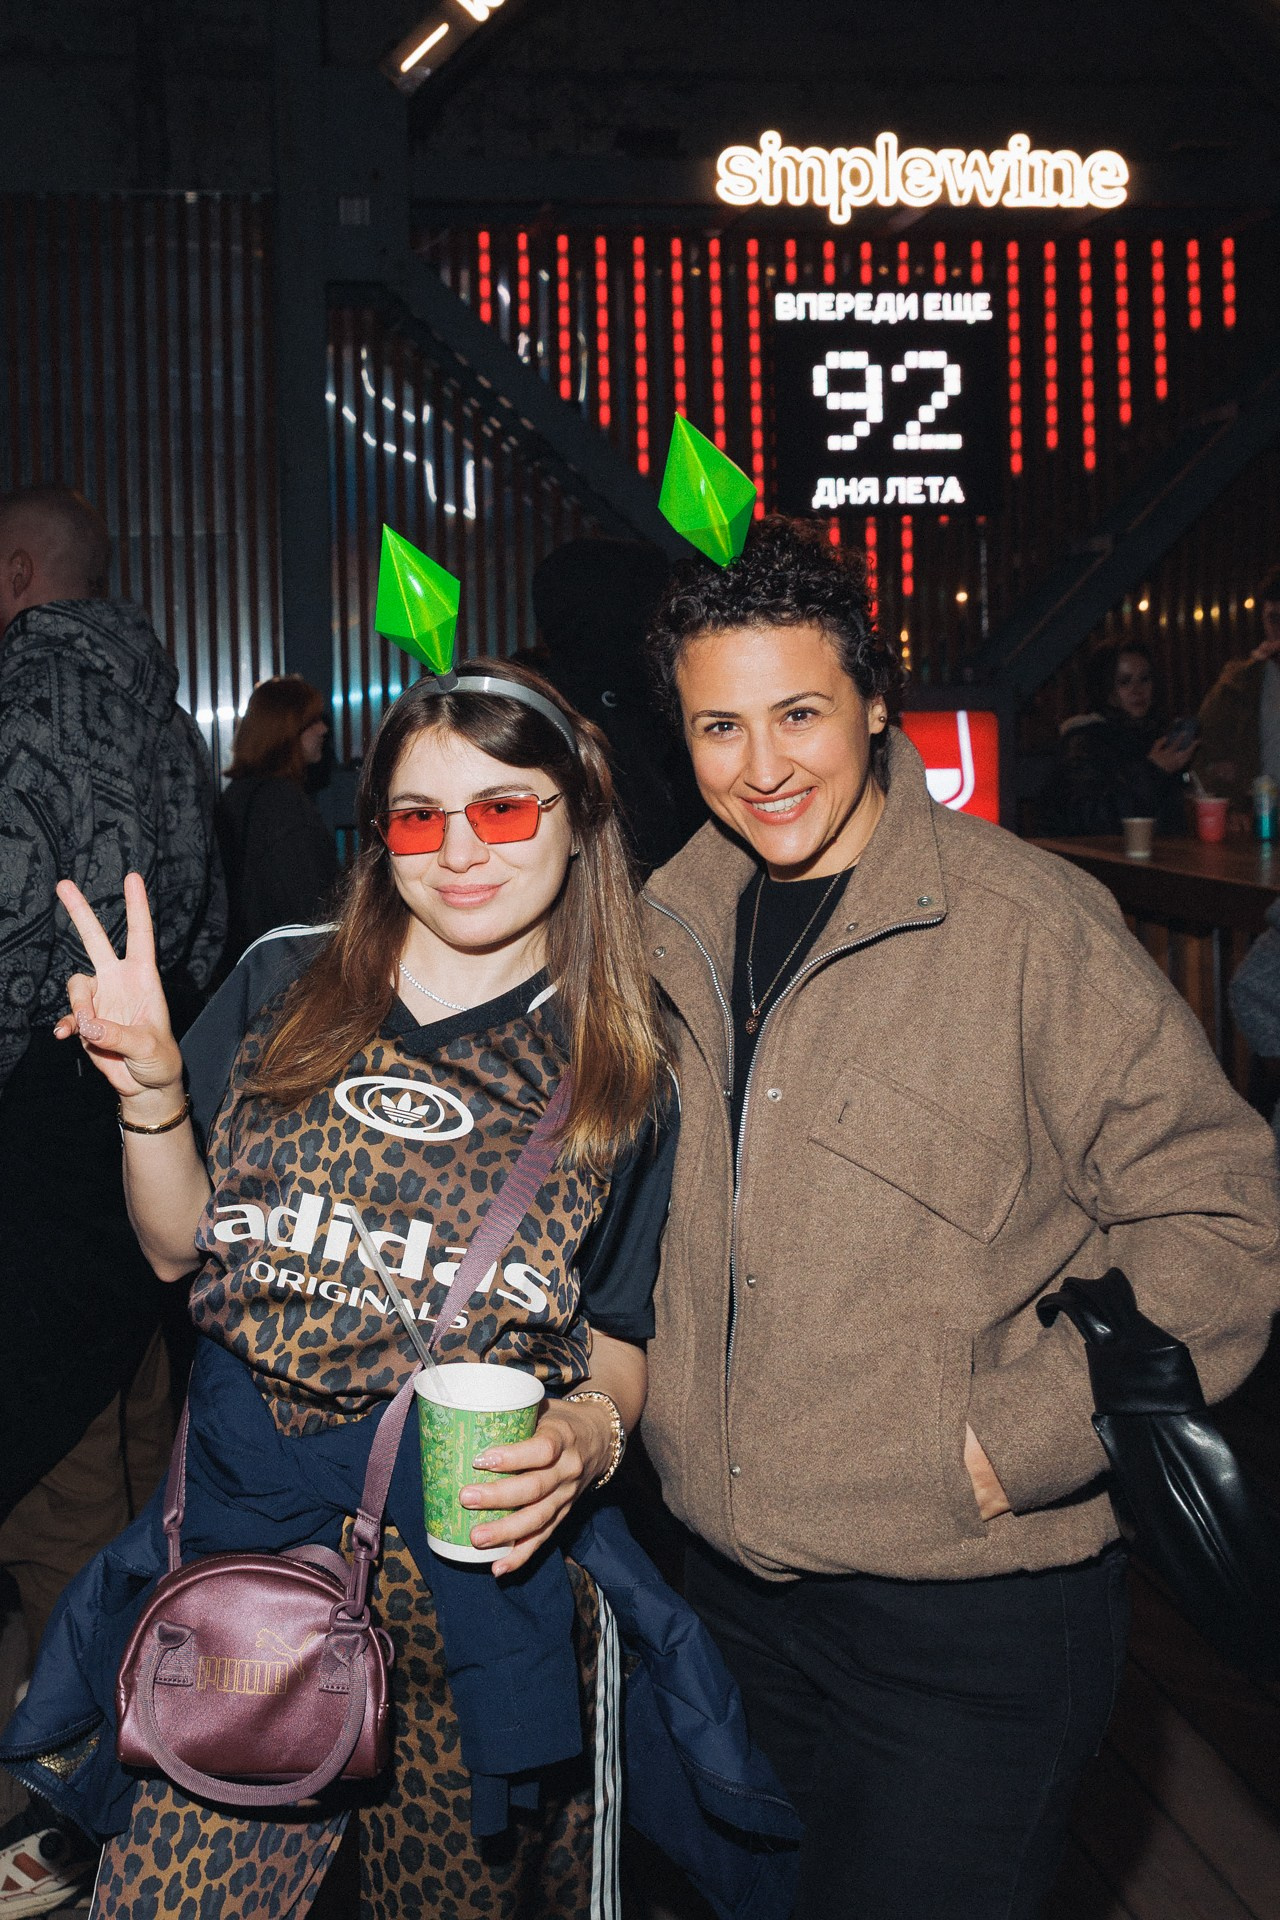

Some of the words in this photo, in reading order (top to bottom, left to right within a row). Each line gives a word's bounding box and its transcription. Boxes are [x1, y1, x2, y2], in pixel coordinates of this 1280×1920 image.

[716, 130, 1130, 225] simplewine
[775, 292, 918, 324] ВПЕРЕДИ
[923, 292, 993, 324] ЕЩЕ
[812, 351, 962, 450] 92
[812, 477, 881, 508] ДНЯ
[884, 476, 965, 504] ЛЕТА
[198, 1656, 289, 1695] PUMA
